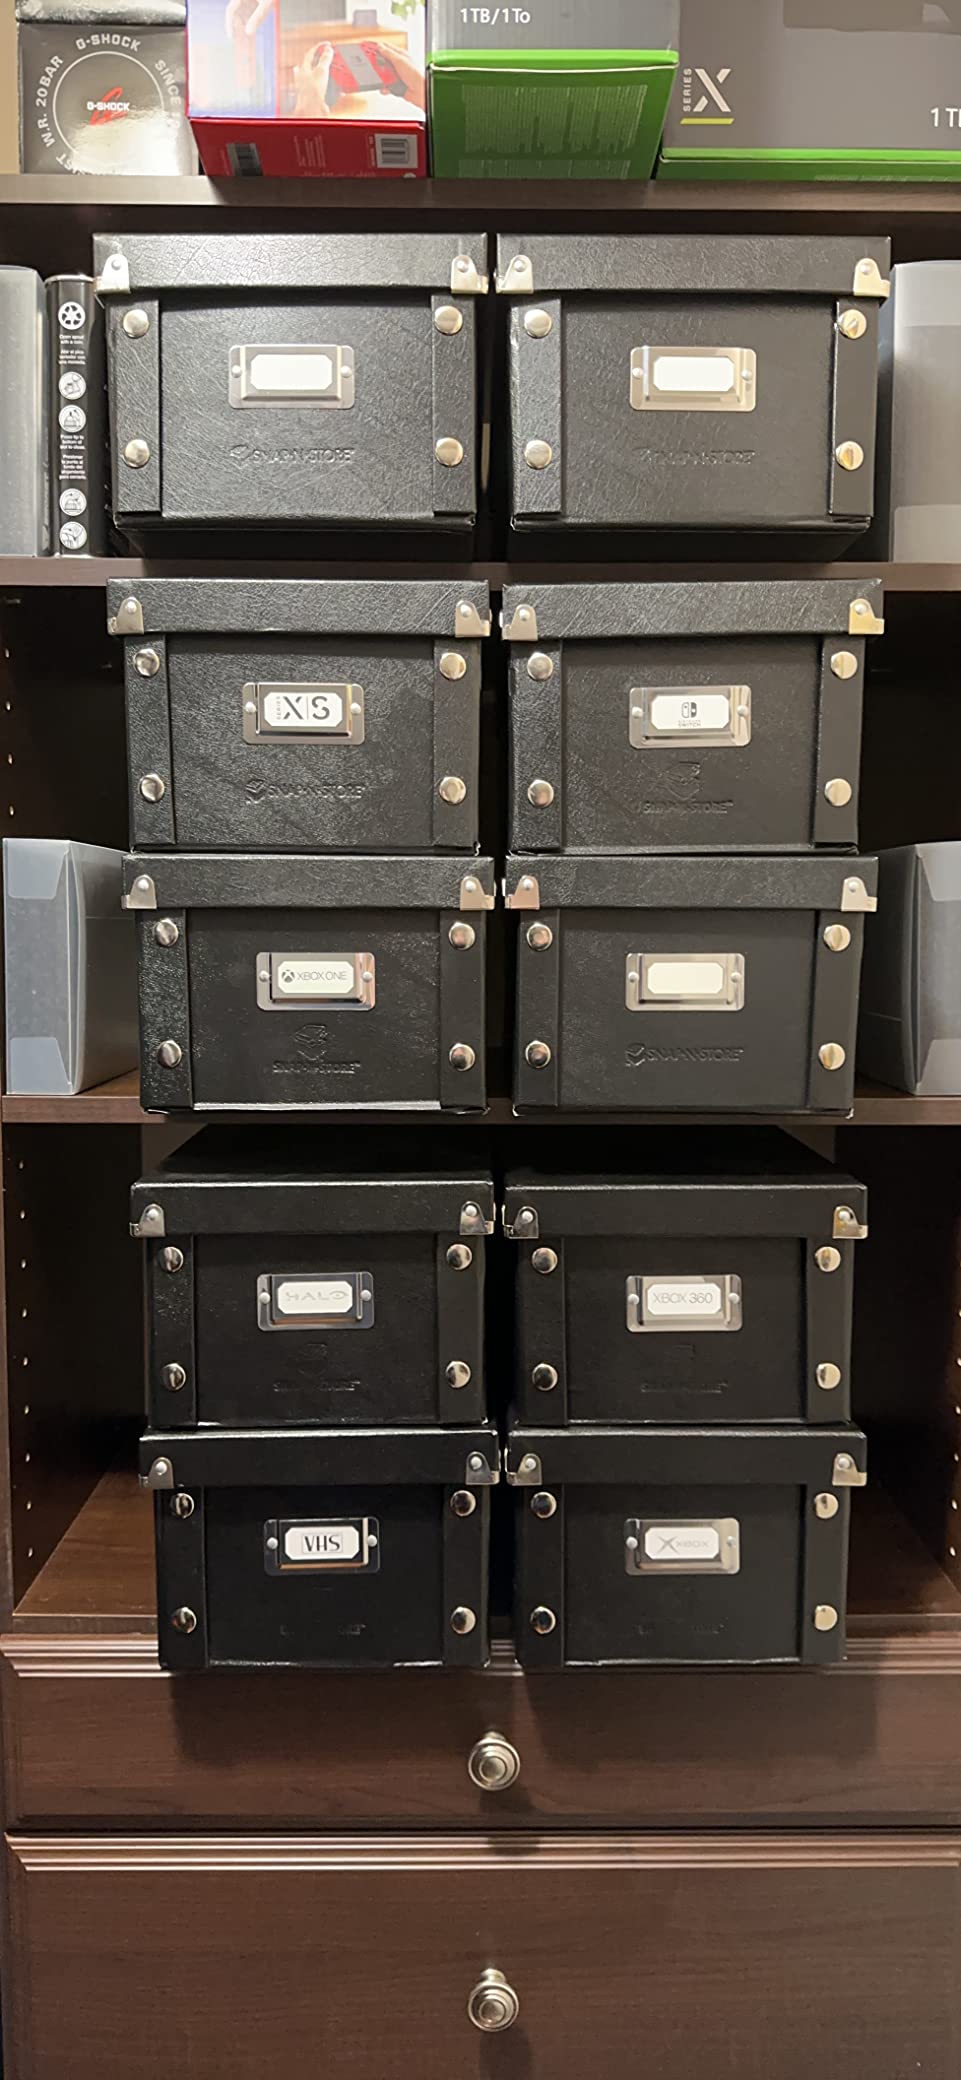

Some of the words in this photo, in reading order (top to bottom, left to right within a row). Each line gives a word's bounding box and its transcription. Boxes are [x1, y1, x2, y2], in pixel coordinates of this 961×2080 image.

[460, 7, 531, 25] 1TB/1To
[75, 33, 141, 52] G-SHOCK
[154, 59, 182, 105] SINCE
[682, 68, 692, 112] SERIES
[692, 68, 732, 112] X
[86, 101, 130, 111] G-SHOCK
[944, 107, 961, 128] T
[37, 113, 56, 148] W.R.
[297, 971, 326, 981] XBOX
[326, 971, 348, 981] ONE
[286, 1290, 350, 1302] HALO
[652, 1292, 688, 1304] XBOX
[688, 1292, 714, 1304] 360
[304, 1534, 341, 1552] VHS
